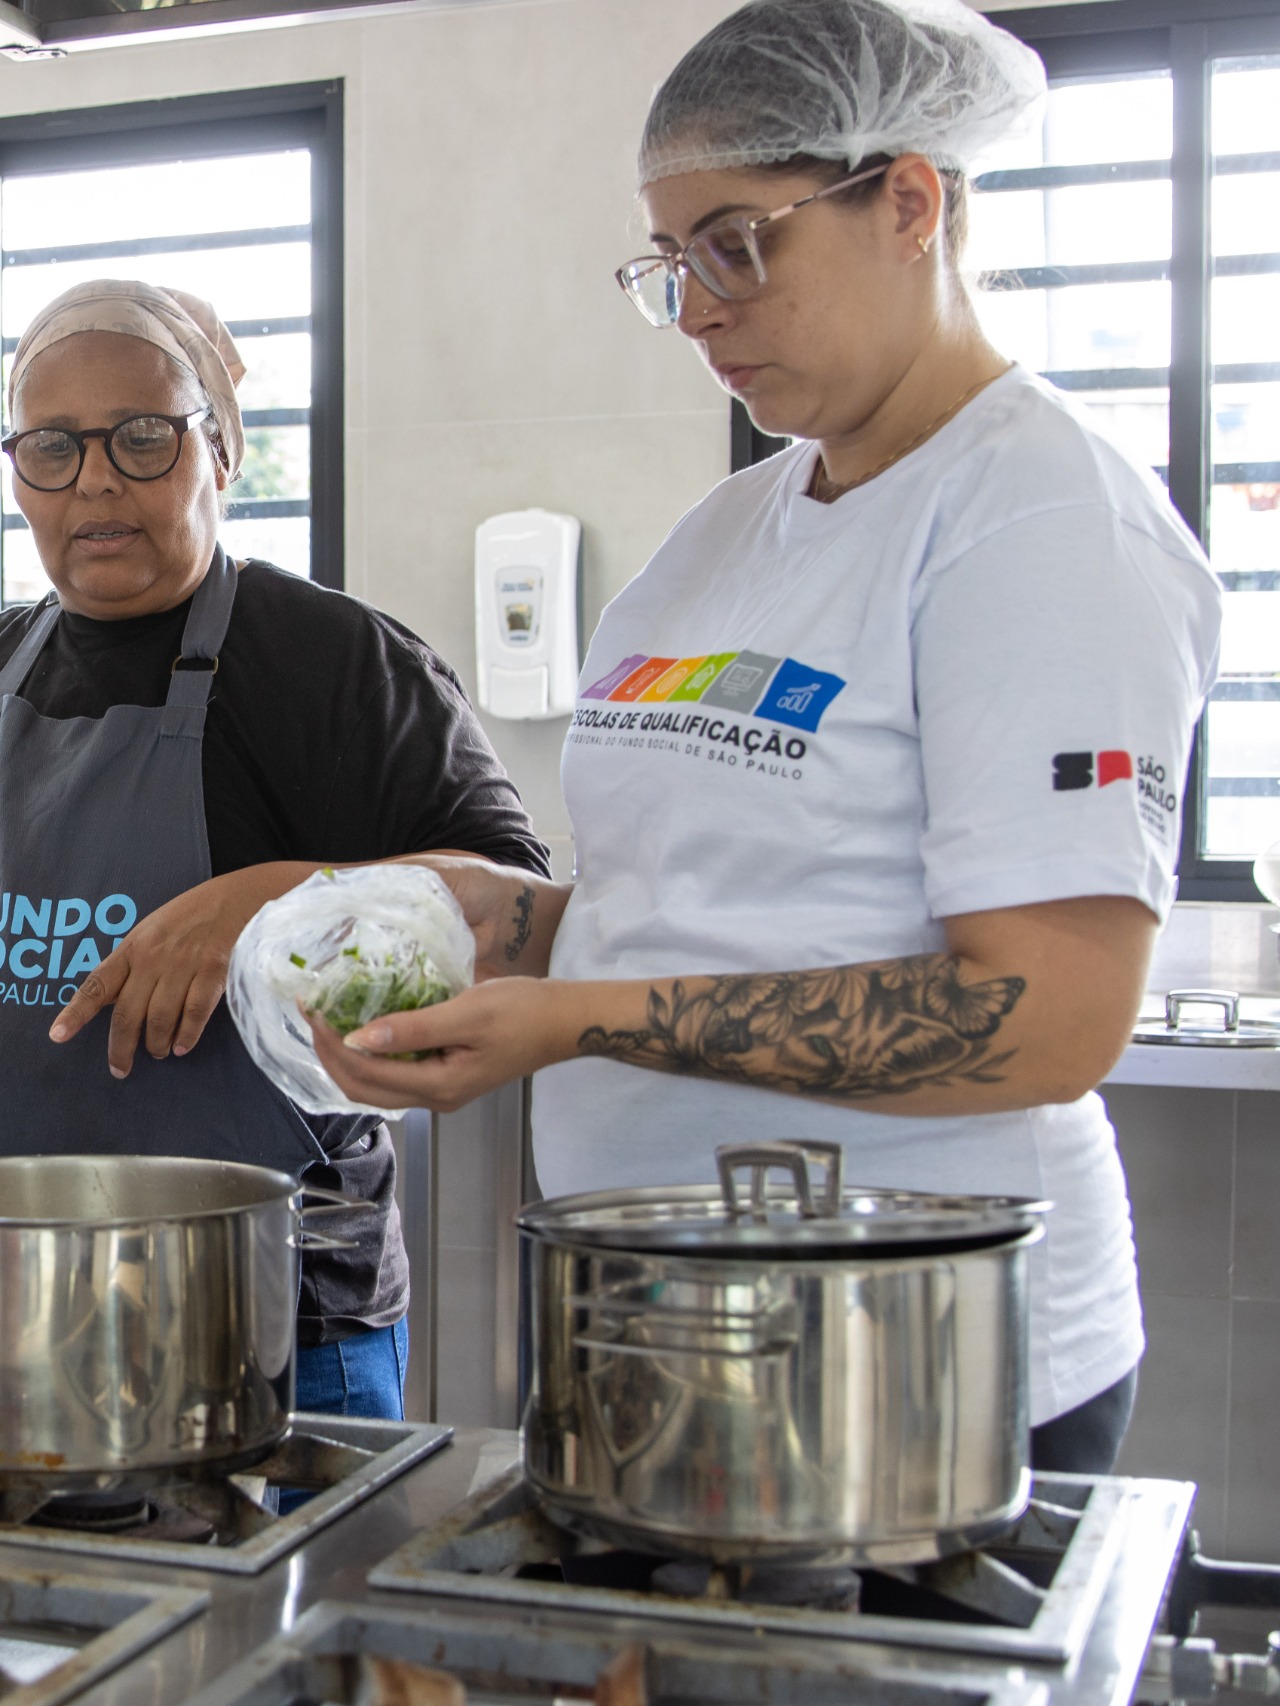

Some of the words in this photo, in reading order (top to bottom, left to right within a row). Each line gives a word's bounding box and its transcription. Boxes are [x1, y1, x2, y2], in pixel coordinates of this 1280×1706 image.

[573, 709, 621, 730] SCOLAS
[618, 711, 641, 730] DE
[639, 712, 807, 760] QUALIFICAÇÃO
[618, 736, 645, 749] FUNDO
[647, 738, 679, 753] SOCIAL
[685, 743, 701, 758] DE
[707, 747, 737, 767] SÃO
[746, 759, 803, 781] PAULO
[1137, 754, 1166, 783] SÃO
[1138, 778, 1177, 813] PAULO
